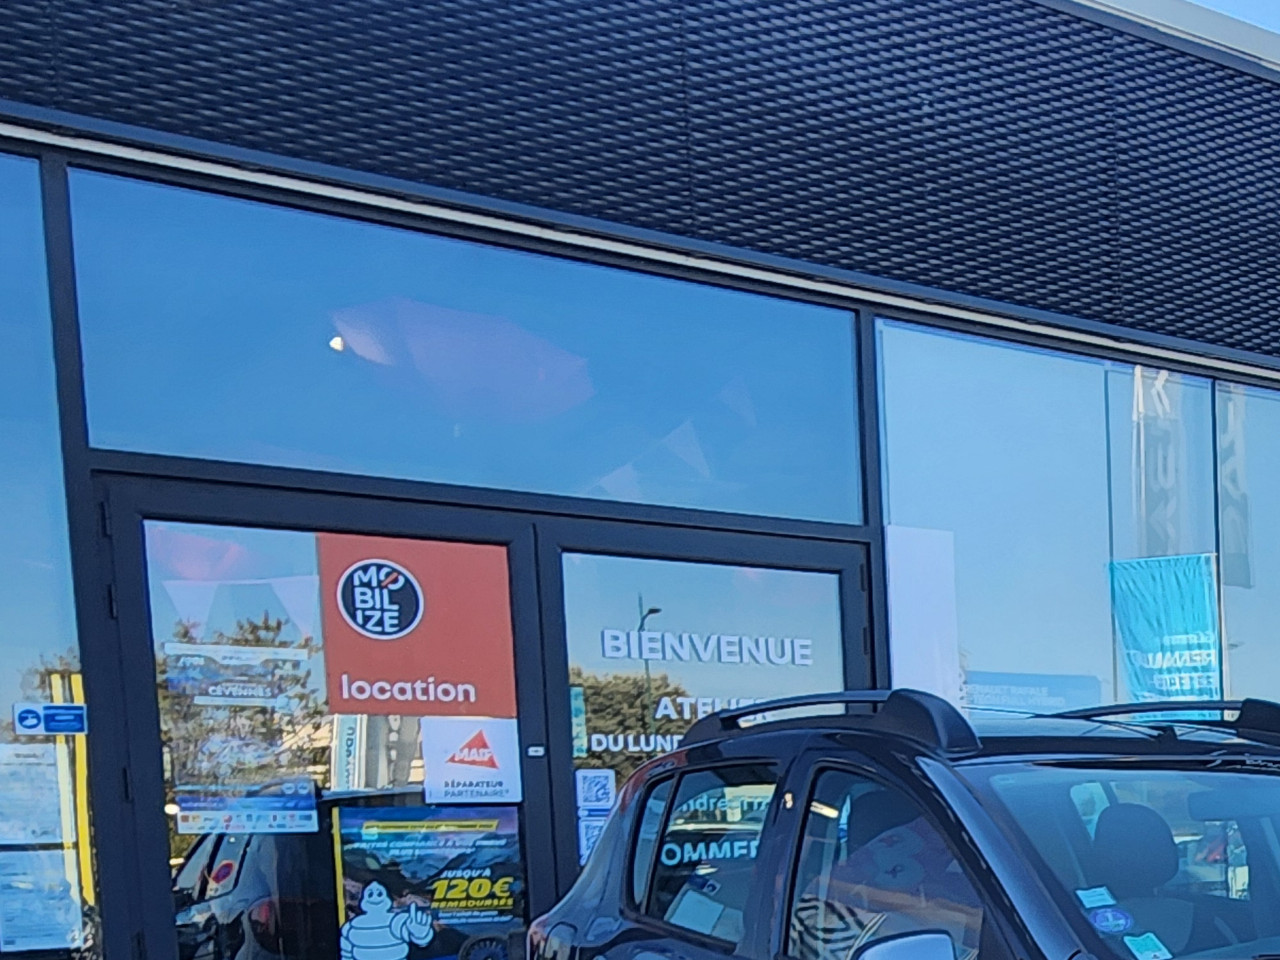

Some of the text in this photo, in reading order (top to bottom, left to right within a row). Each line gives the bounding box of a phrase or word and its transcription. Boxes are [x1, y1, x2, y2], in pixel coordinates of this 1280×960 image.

[602, 629, 813, 666] BIENVENUE
[341, 673, 476, 702] location
[590, 734, 624, 751] DU
[431, 876, 514, 899] 120€
